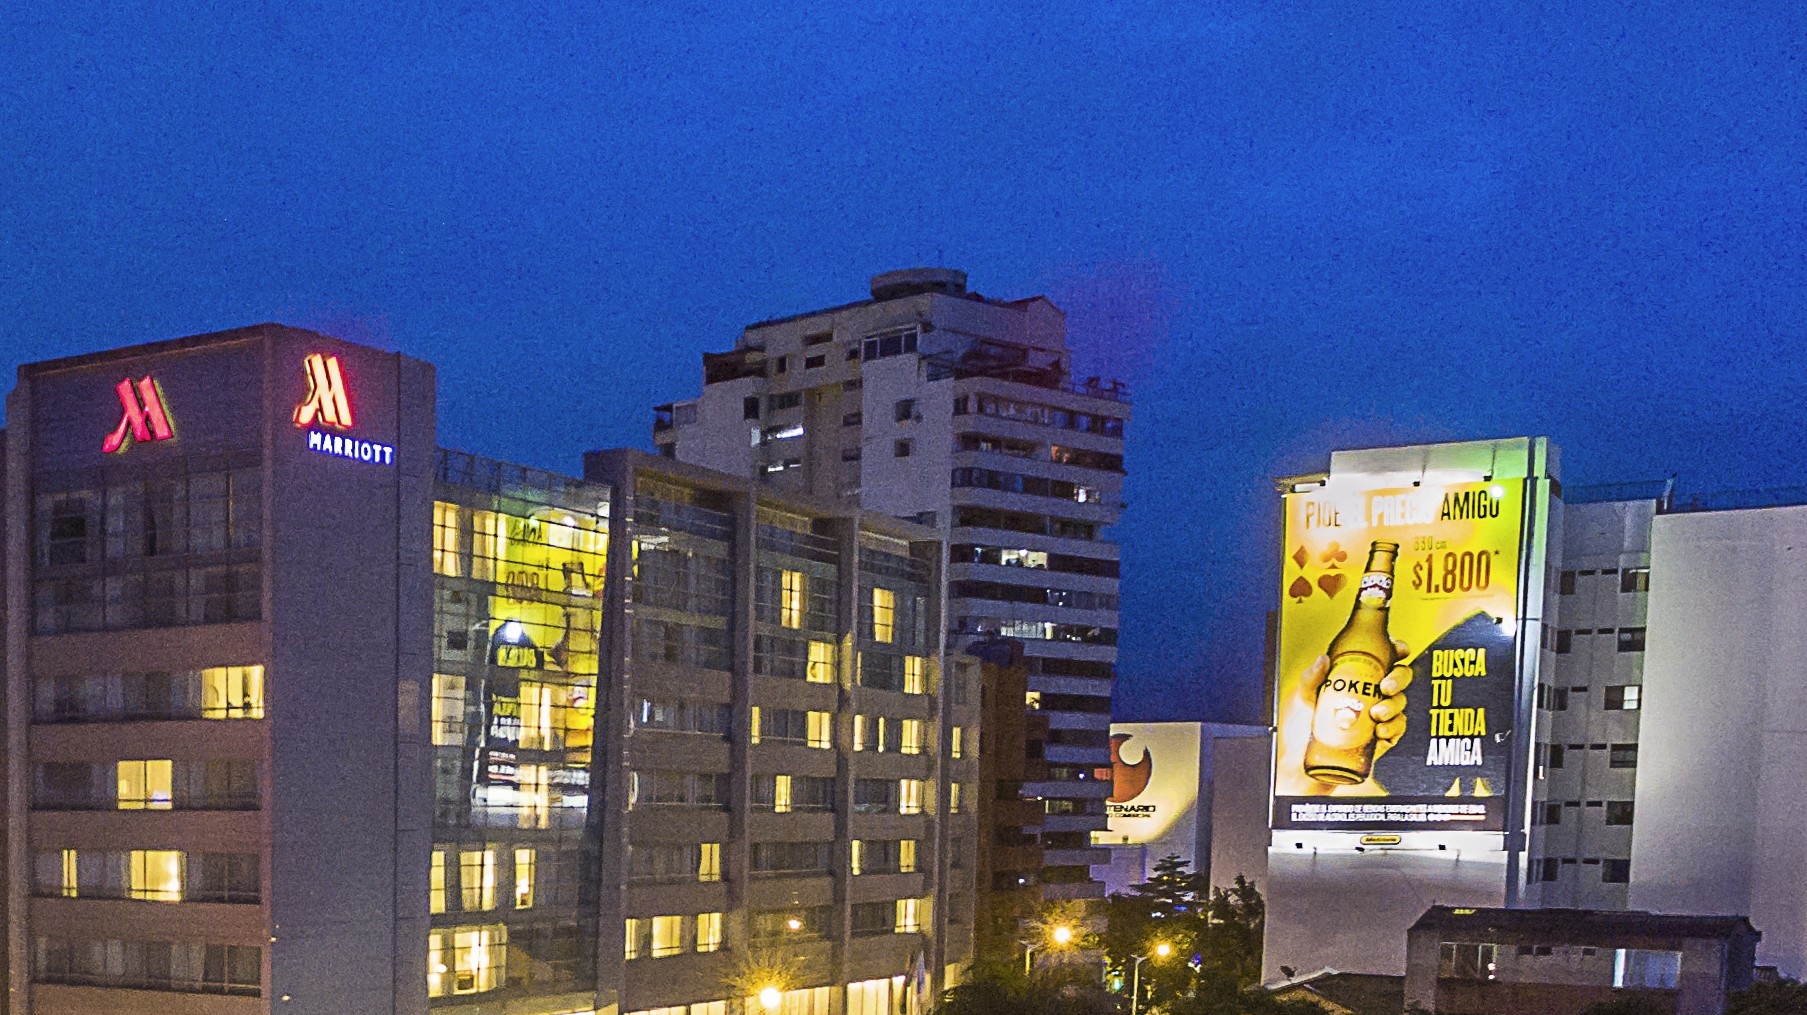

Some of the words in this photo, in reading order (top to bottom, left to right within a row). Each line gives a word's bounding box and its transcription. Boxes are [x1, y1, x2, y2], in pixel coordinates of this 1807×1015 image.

[308, 430, 393, 465] MARRIOTT
[1440, 489, 1500, 521] AMIGO
[1432, 647, 1487, 677] BUSCA
[1323, 678, 1381, 699] POKER
[1431, 679, 1452, 706] TU
[1429, 707, 1487, 736] TIENDA
[1426, 737, 1483, 766] AMIGA
